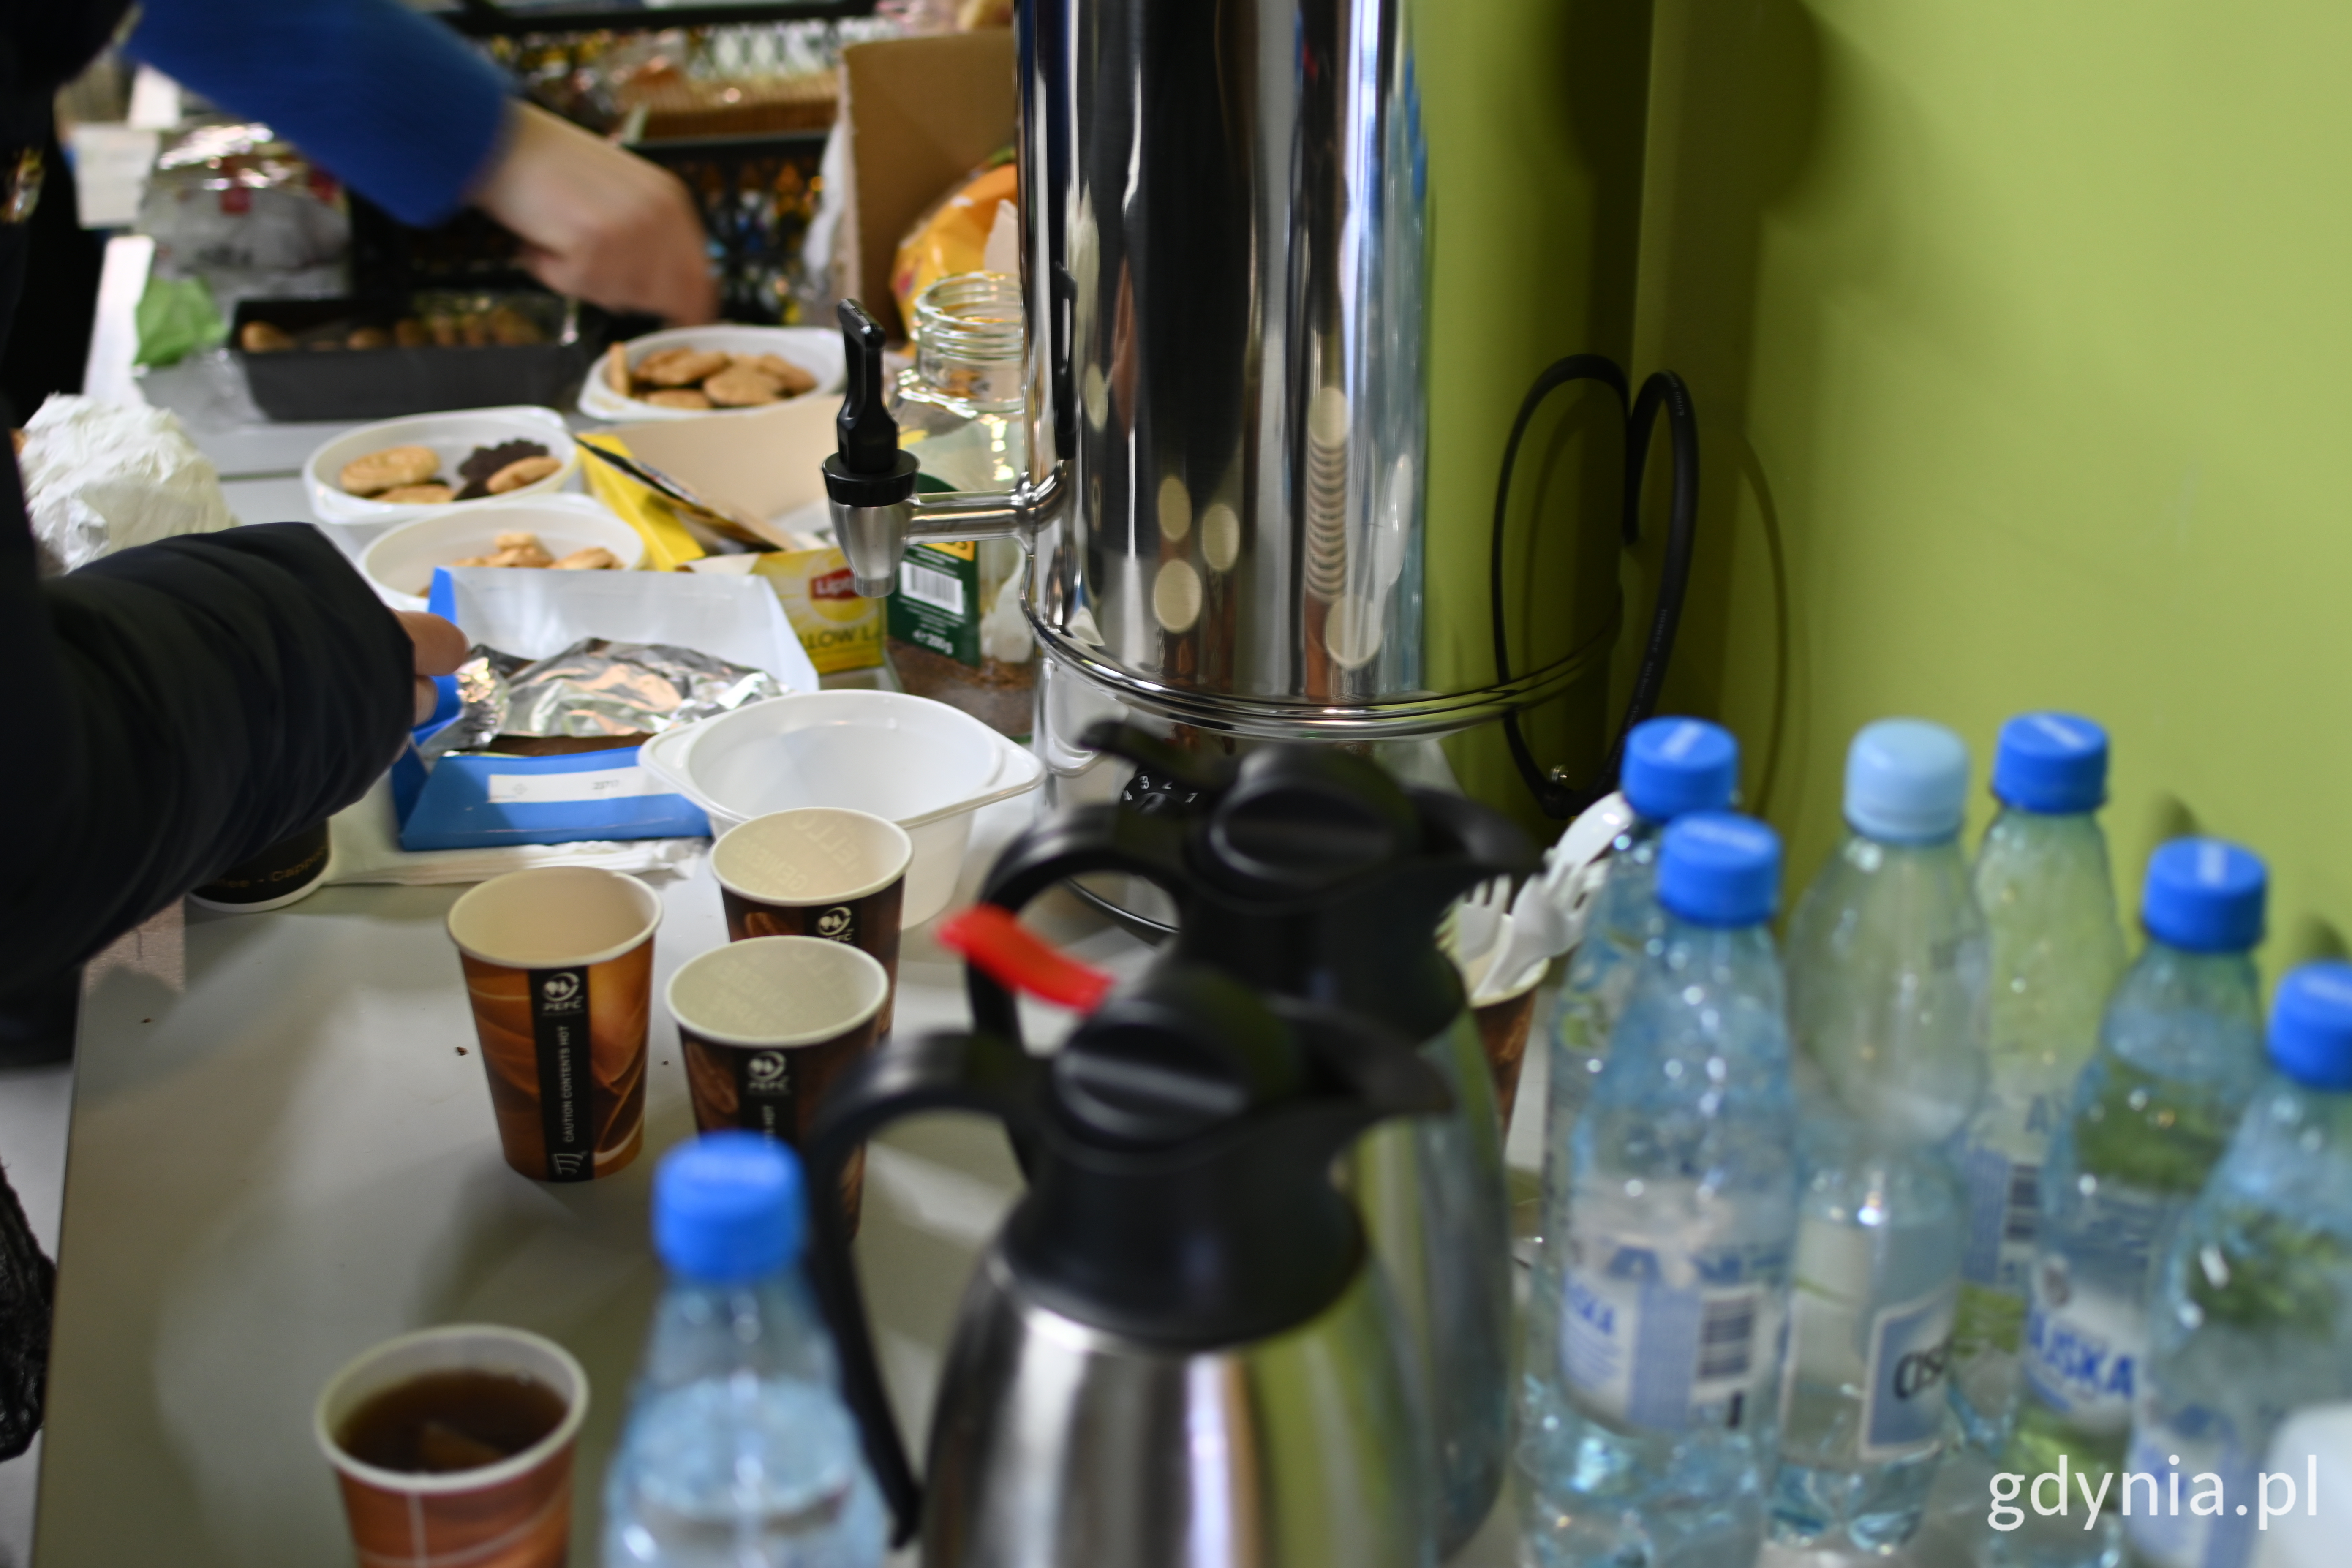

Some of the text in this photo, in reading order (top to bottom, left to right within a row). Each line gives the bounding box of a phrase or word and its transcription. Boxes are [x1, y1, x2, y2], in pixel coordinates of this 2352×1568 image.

[1140, 776, 1149, 789] 3
[556, 1026, 574, 1143] CAUTION CONTENTS HOT
